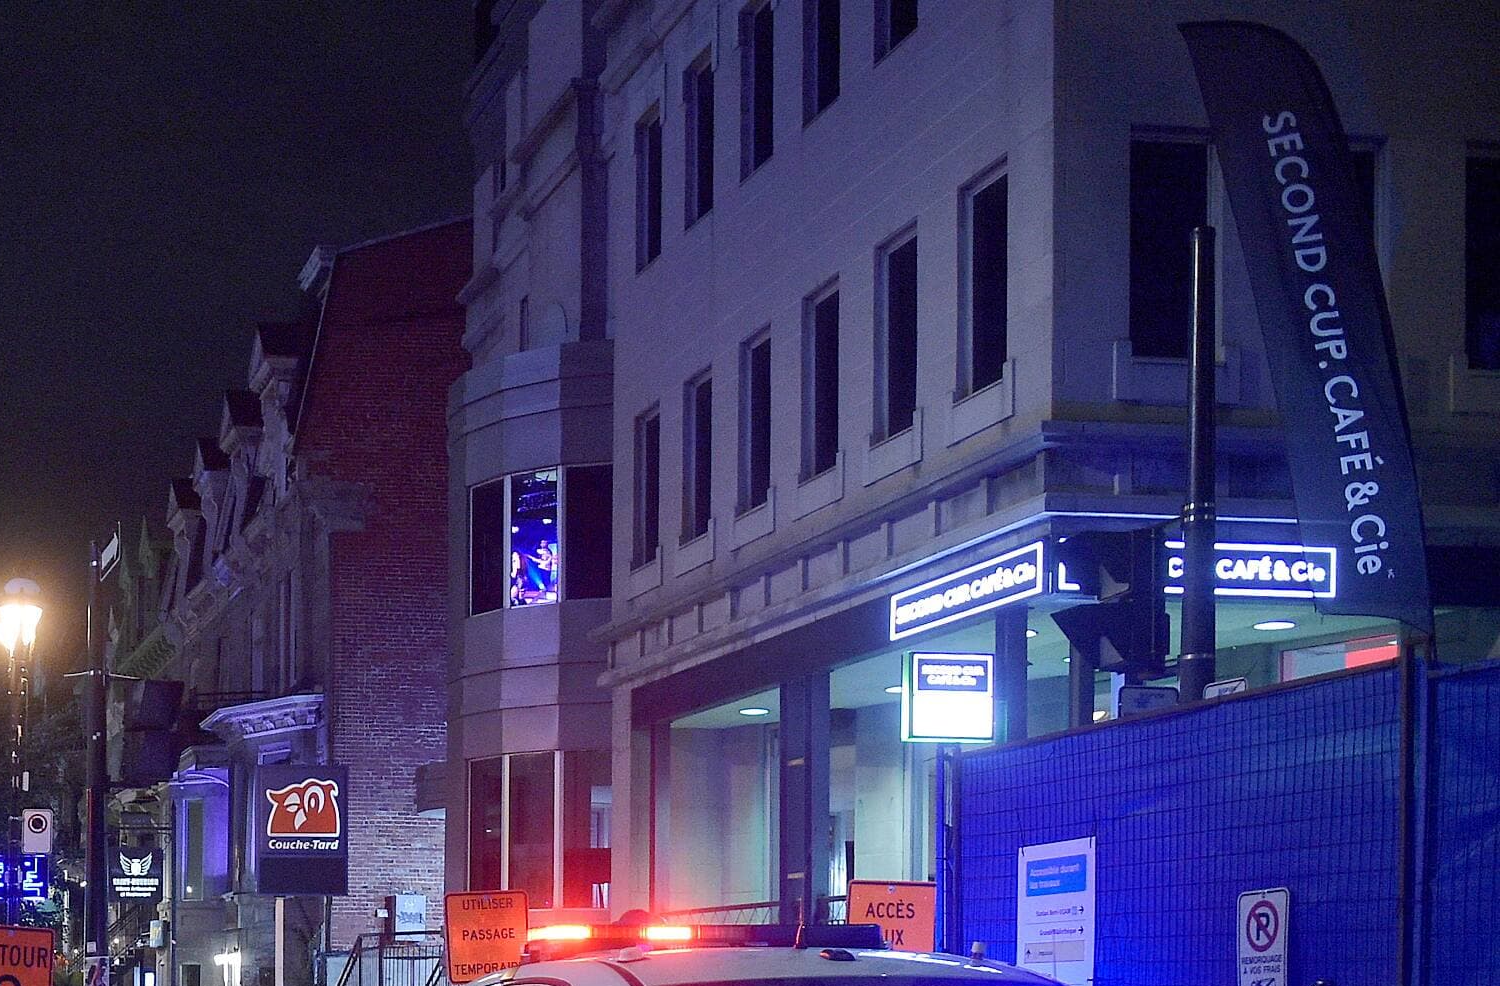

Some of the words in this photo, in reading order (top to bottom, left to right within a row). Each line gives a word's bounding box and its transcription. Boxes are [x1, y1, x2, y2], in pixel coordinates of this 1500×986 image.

[1262, 110, 1328, 273] SECOND
[1304, 283, 1348, 369] CUP.
[1324, 375, 1384, 475] CAFÉ
[1350, 514, 1390, 575] Cie
[1215, 556, 1272, 581] CAFÉ
[268, 839, 339, 850] Couche-Tard
[462, 897, 514, 911] UTILISER
[865, 899, 915, 919] ACCÈS
[462, 928, 515, 941] PASSAGE
[885, 929, 904, 945] UX
